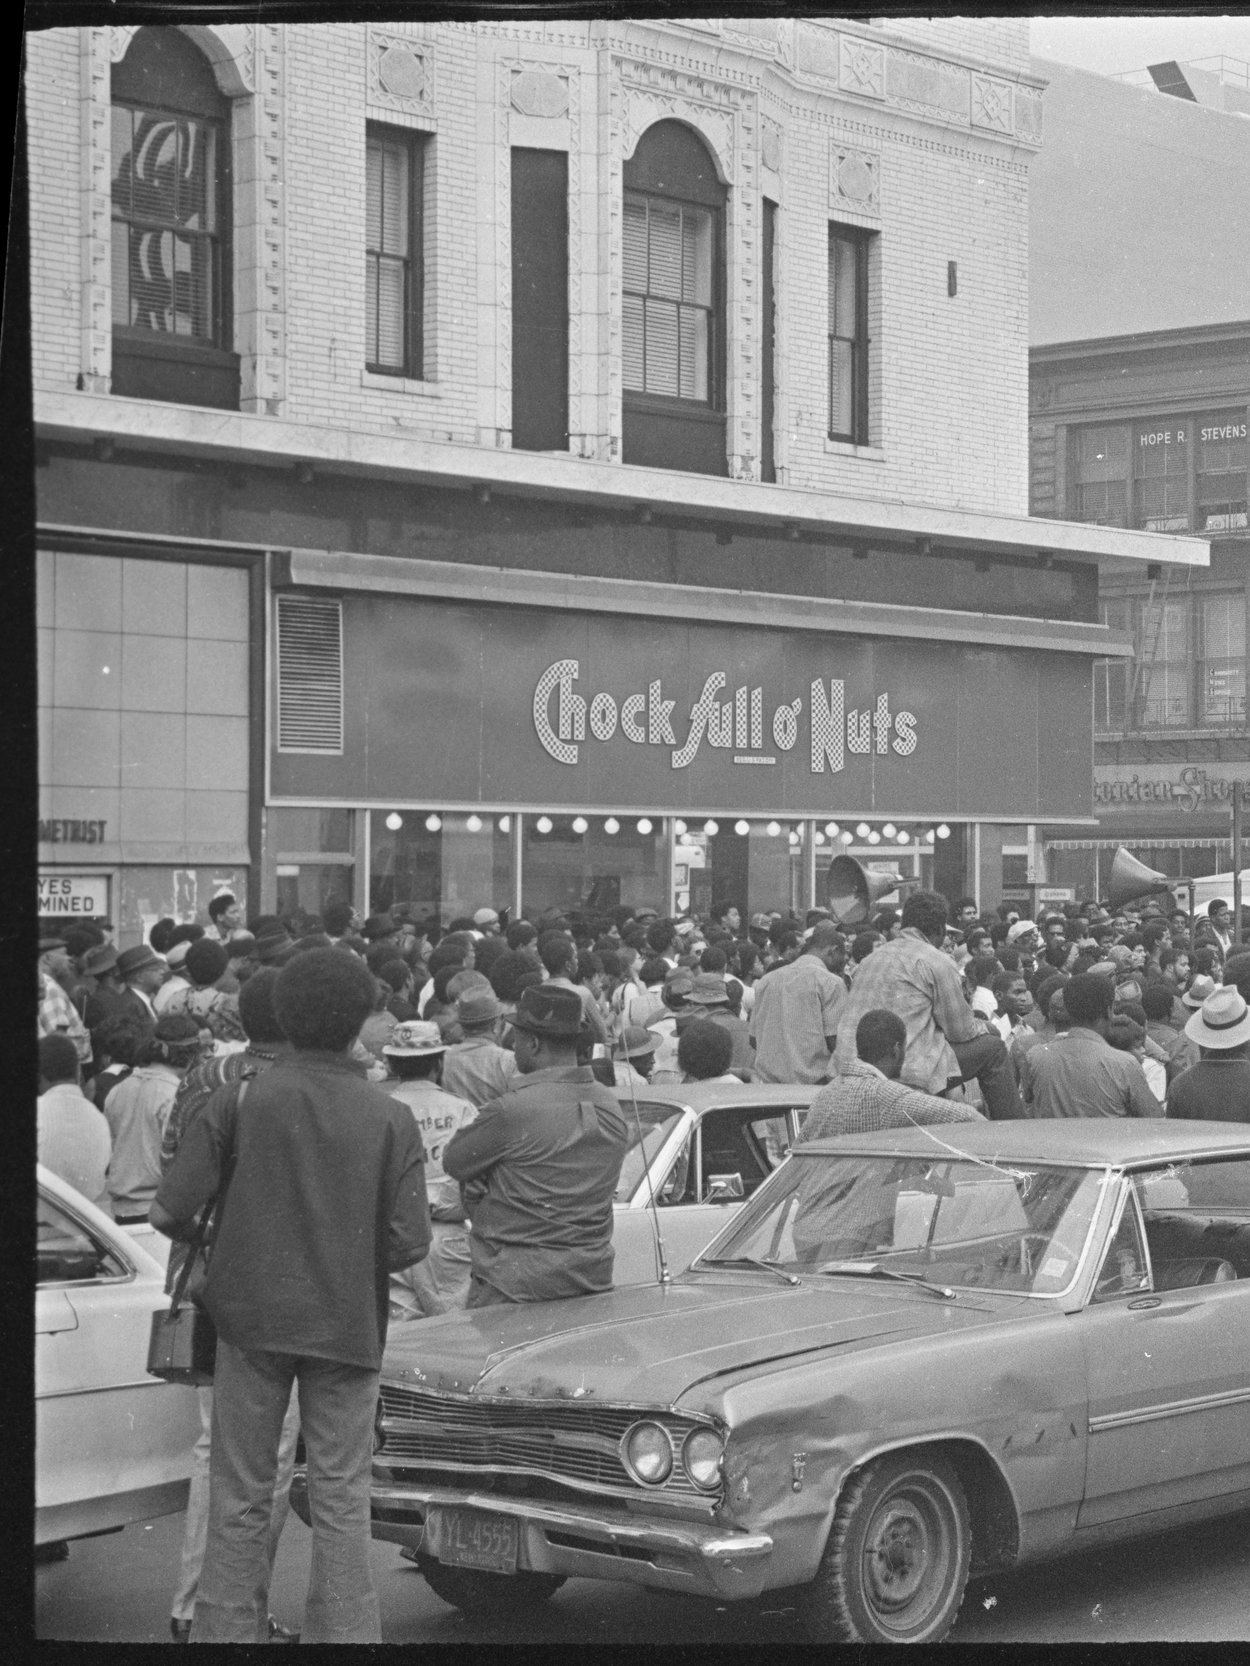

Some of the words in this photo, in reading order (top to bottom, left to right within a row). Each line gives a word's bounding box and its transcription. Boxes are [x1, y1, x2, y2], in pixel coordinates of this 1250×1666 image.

[1140, 433, 1171, 446] HOPE
[1201, 424, 1247, 441] STEVENS
[533, 659, 677, 765] Chock
[671, 671, 763, 768] full
[811, 677, 918, 773] Nuts
